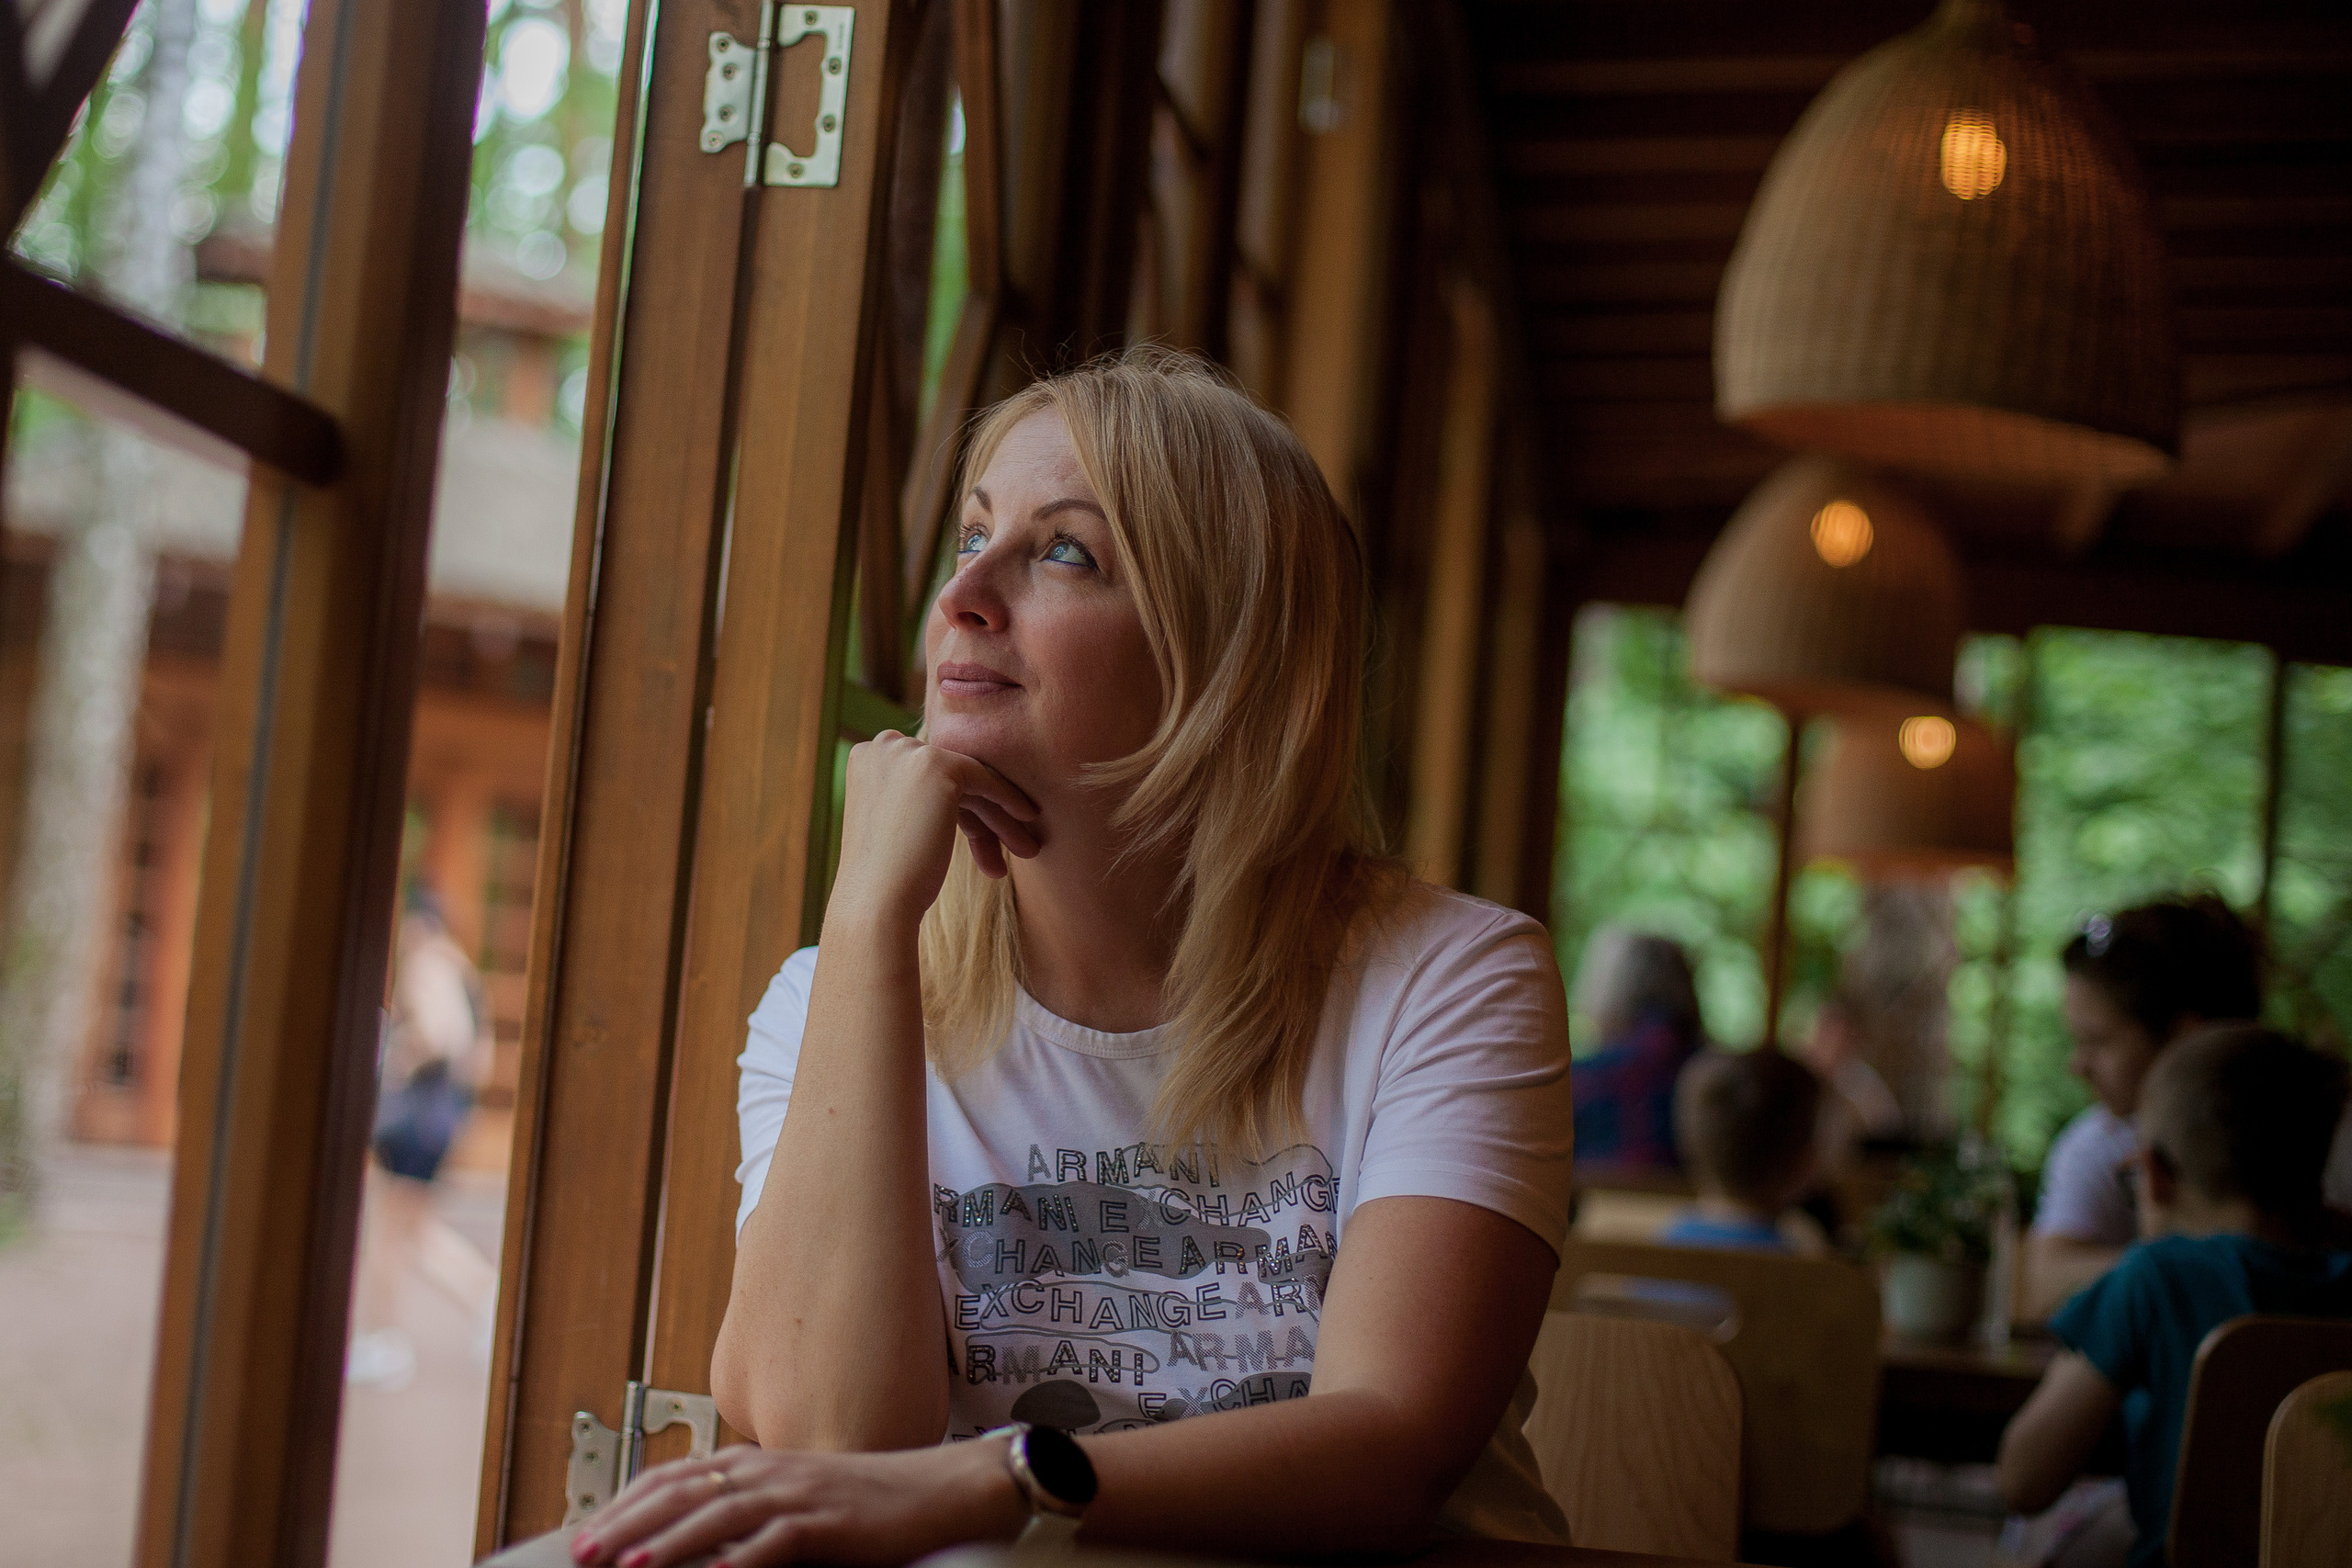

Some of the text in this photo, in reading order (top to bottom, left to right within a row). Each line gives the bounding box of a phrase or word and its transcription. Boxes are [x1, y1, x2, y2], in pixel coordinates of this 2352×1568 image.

[1027, 1142, 1220, 1189] ARMANI
[955, 1279, 1227, 1331] EXCHANGE
[948, 1337, 1144, 1386] RMANI
